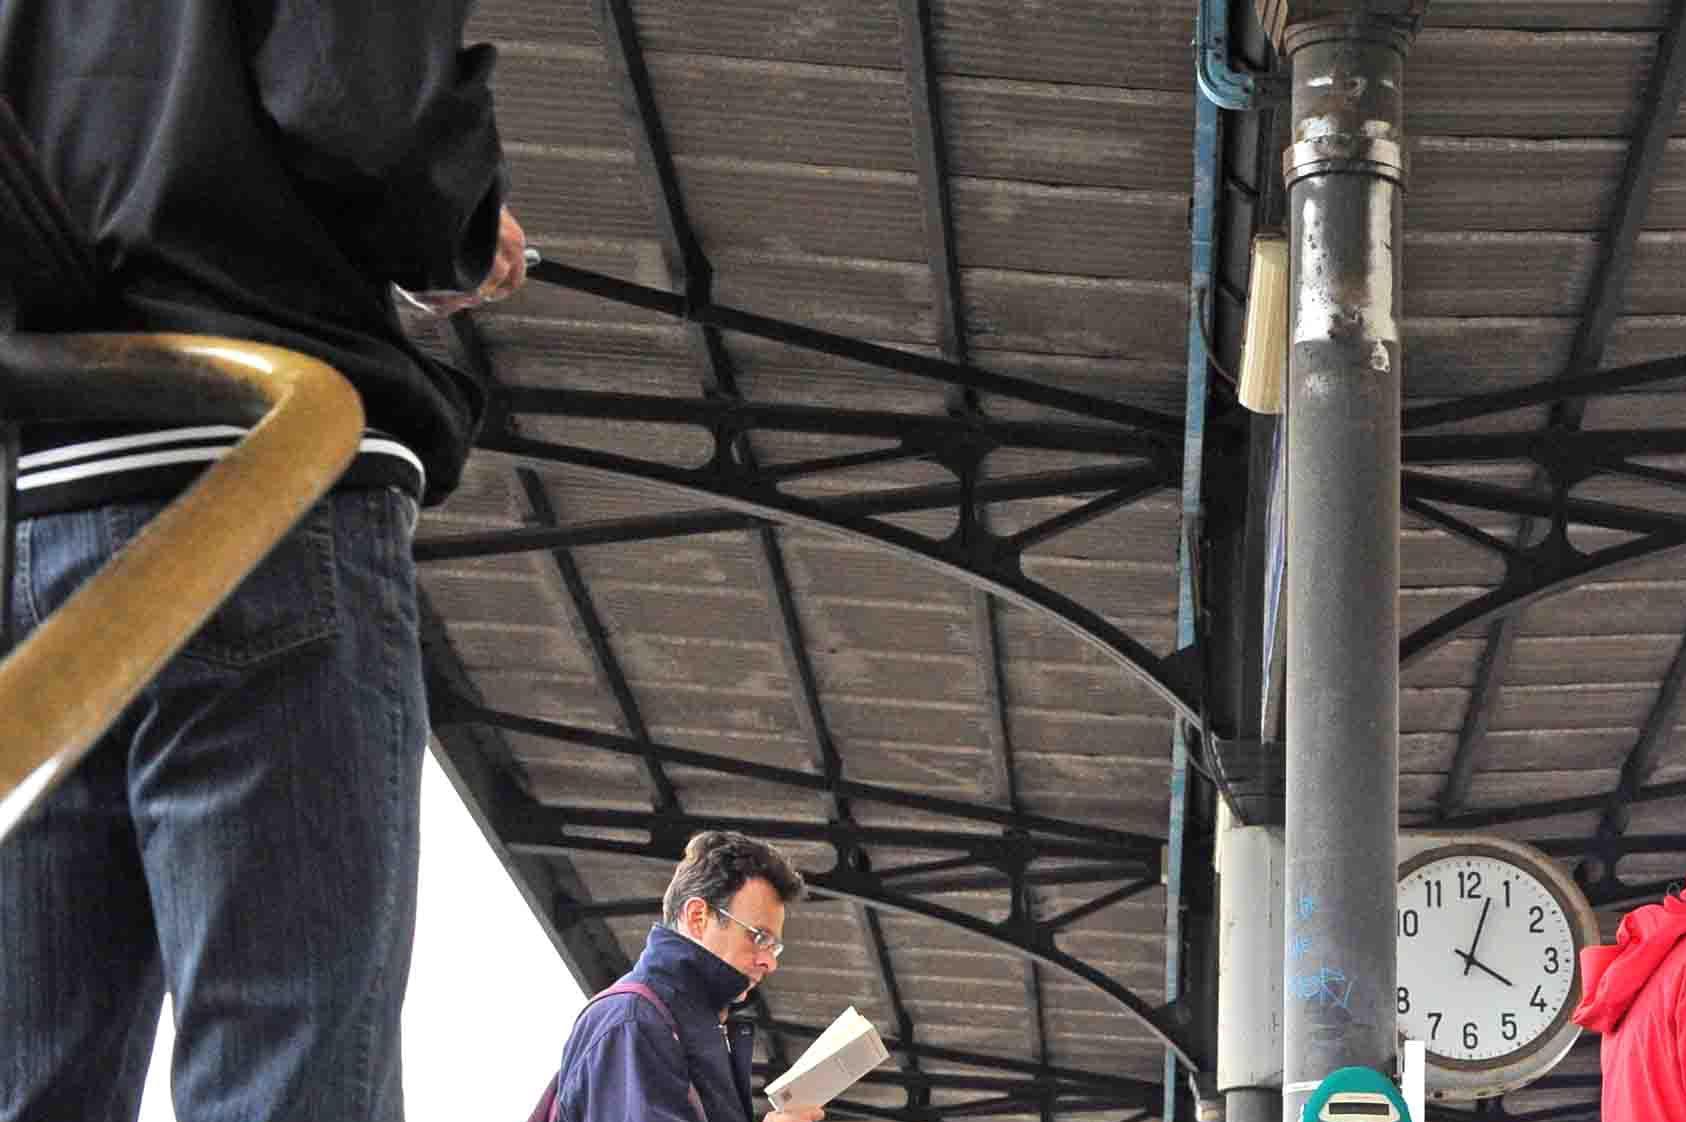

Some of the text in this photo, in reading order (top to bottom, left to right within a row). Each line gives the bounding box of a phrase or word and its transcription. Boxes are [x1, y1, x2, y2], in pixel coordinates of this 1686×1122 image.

[1424, 880, 1442, 908] 11
[1457, 871, 1482, 899] 12
[1502, 879, 1511, 908] 1
[1528, 905, 1545, 933] 2
[1543, 947, 1560, 975] 3
[1397, 987, 1411, 1014] 8
[1529, 985, 1548, 1013] 4
[1427, 1013, 1443, 1041] 7
[1462, 1023, 1479, 1050] 6
[1501, 1013, 1518, 1041] 5
